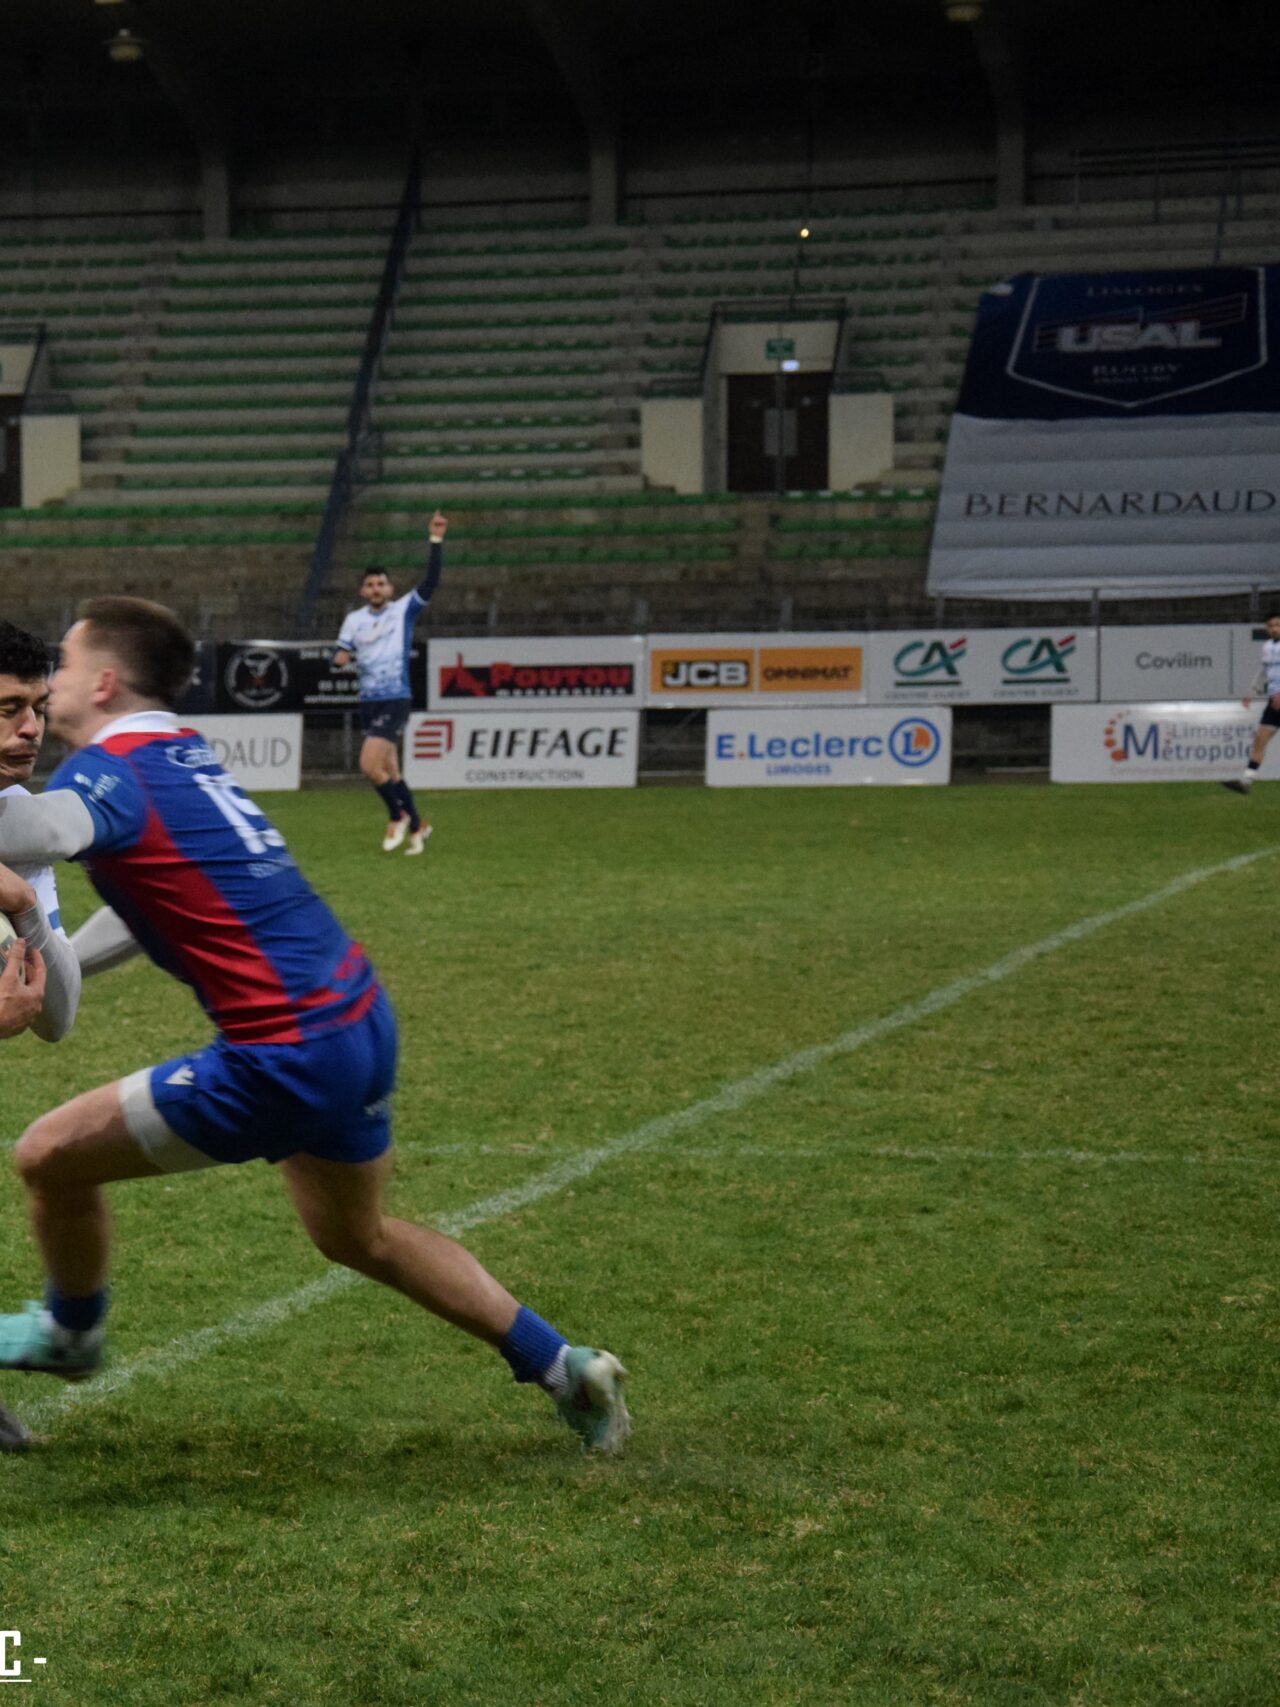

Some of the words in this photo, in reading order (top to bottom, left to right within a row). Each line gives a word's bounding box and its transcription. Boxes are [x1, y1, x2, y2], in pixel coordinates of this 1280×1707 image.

[1057, 319, 1223, 353] USAL
[964, 489, 1277, 517] BERNARDAUD
[662, 661, 749, 687] JCB
[1135, 652, 1213, 670] Covilim
[467, 727, 629, 759] EIFFAGE
[1172, 722, 1257, 742] Limoges
[715, 732, 883, 760] E.Leclerc
[465, 769, 584, 782] CONSTRUCTION
[766, 763, 832, 776] LIMOGES
